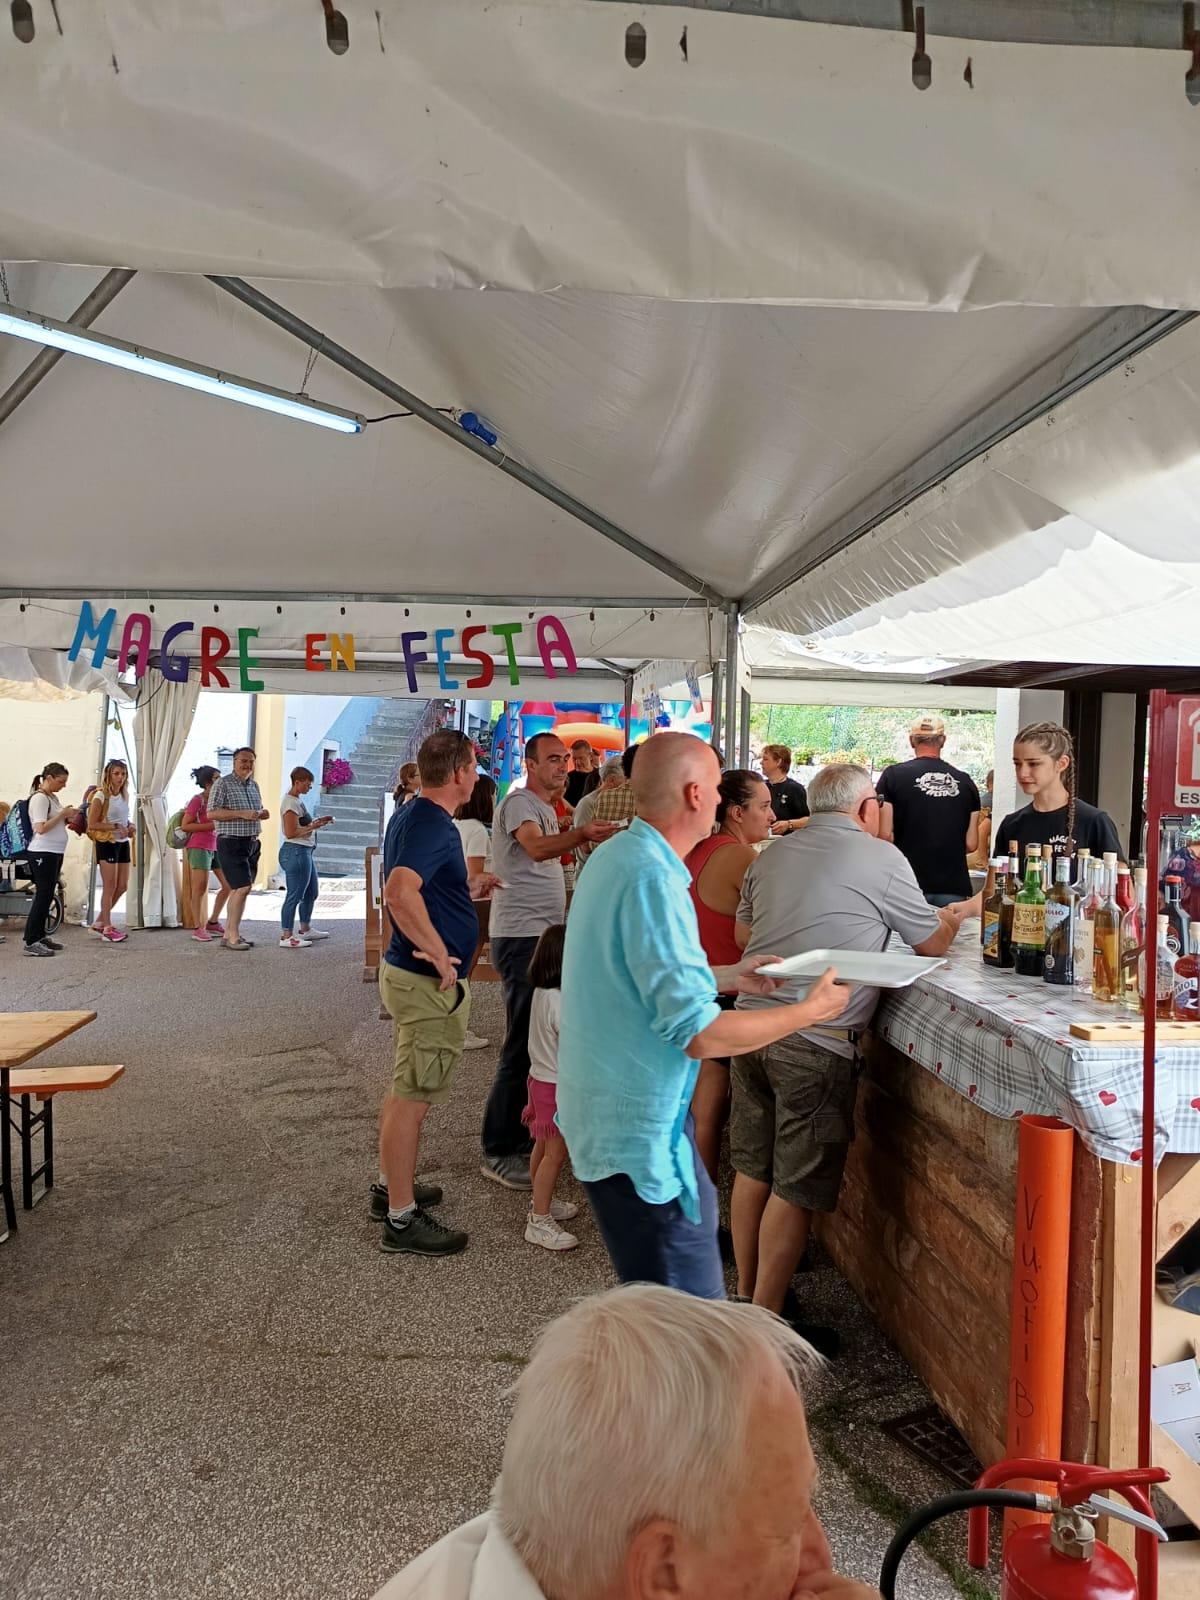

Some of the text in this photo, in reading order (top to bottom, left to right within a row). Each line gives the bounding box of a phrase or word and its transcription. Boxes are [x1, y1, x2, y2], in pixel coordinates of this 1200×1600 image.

[67, 600, 578, 693] MAGRE EN FESTA
